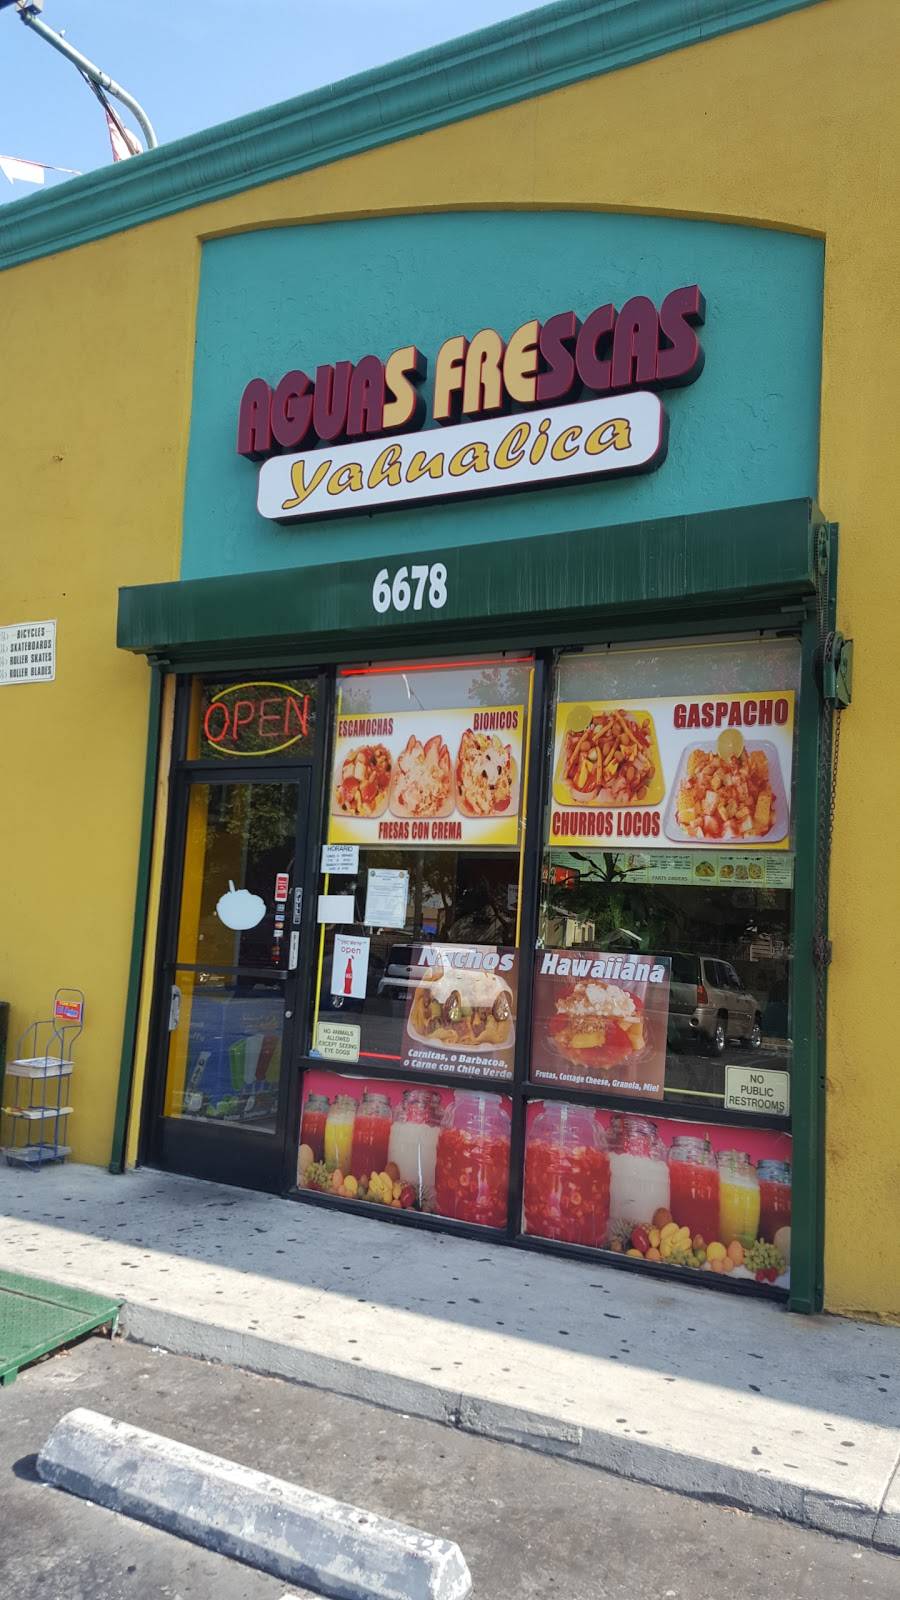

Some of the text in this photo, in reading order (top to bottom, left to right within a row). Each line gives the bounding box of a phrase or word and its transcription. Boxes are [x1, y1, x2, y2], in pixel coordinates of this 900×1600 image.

[237, 285, 704, 458] AGUAS FRESCAS
[372, 562, 448, 613] 6678
[17, 627, 45, 638] BICYCLES
[10, 640, 52, 652] SKATEBOARDS
[10, 652, 52, 665] ROLLER SKATES
[10, 666, 52, 678] ROLLER BLADES
[204, 694, 310, 742] OPEN
[473, 710, 519, 731] BIONICOS
[673, 698, 789, 729] GASPACHO
[338, 717, 394, 738] ESCAMOCHAS
[378, 821, 462, 840] FRESAS CON CREMA
[552, 811, 660, 837] CHURROS LOCOS
[341, 946, 361, 955] open
[540, 953, 665, 983] Hawaiiana
[318, 1040, 337, 1048] EXCEPT
[335, 1048, 351, 1056] DOGS
[407, 1049, 448, 1062] Carnitas,
[458, 1054, 508, 1069] Barbacoa,
[411, 1059, 437, 1070] Carne
[439, 1064, 456, 1072] con
[457, 1064, 481, 1075] Chile
[482, 1068, 513, 1079] Verde
[535, 1070, 660, 1093] Frutas, Cottage Cheese, Granola, Miel
[750, 1074, 764, 1084] NO
[741, 1085, 774, 1098] PUBLIC
[729, 1095, 785, 1111] RESTROOMS
